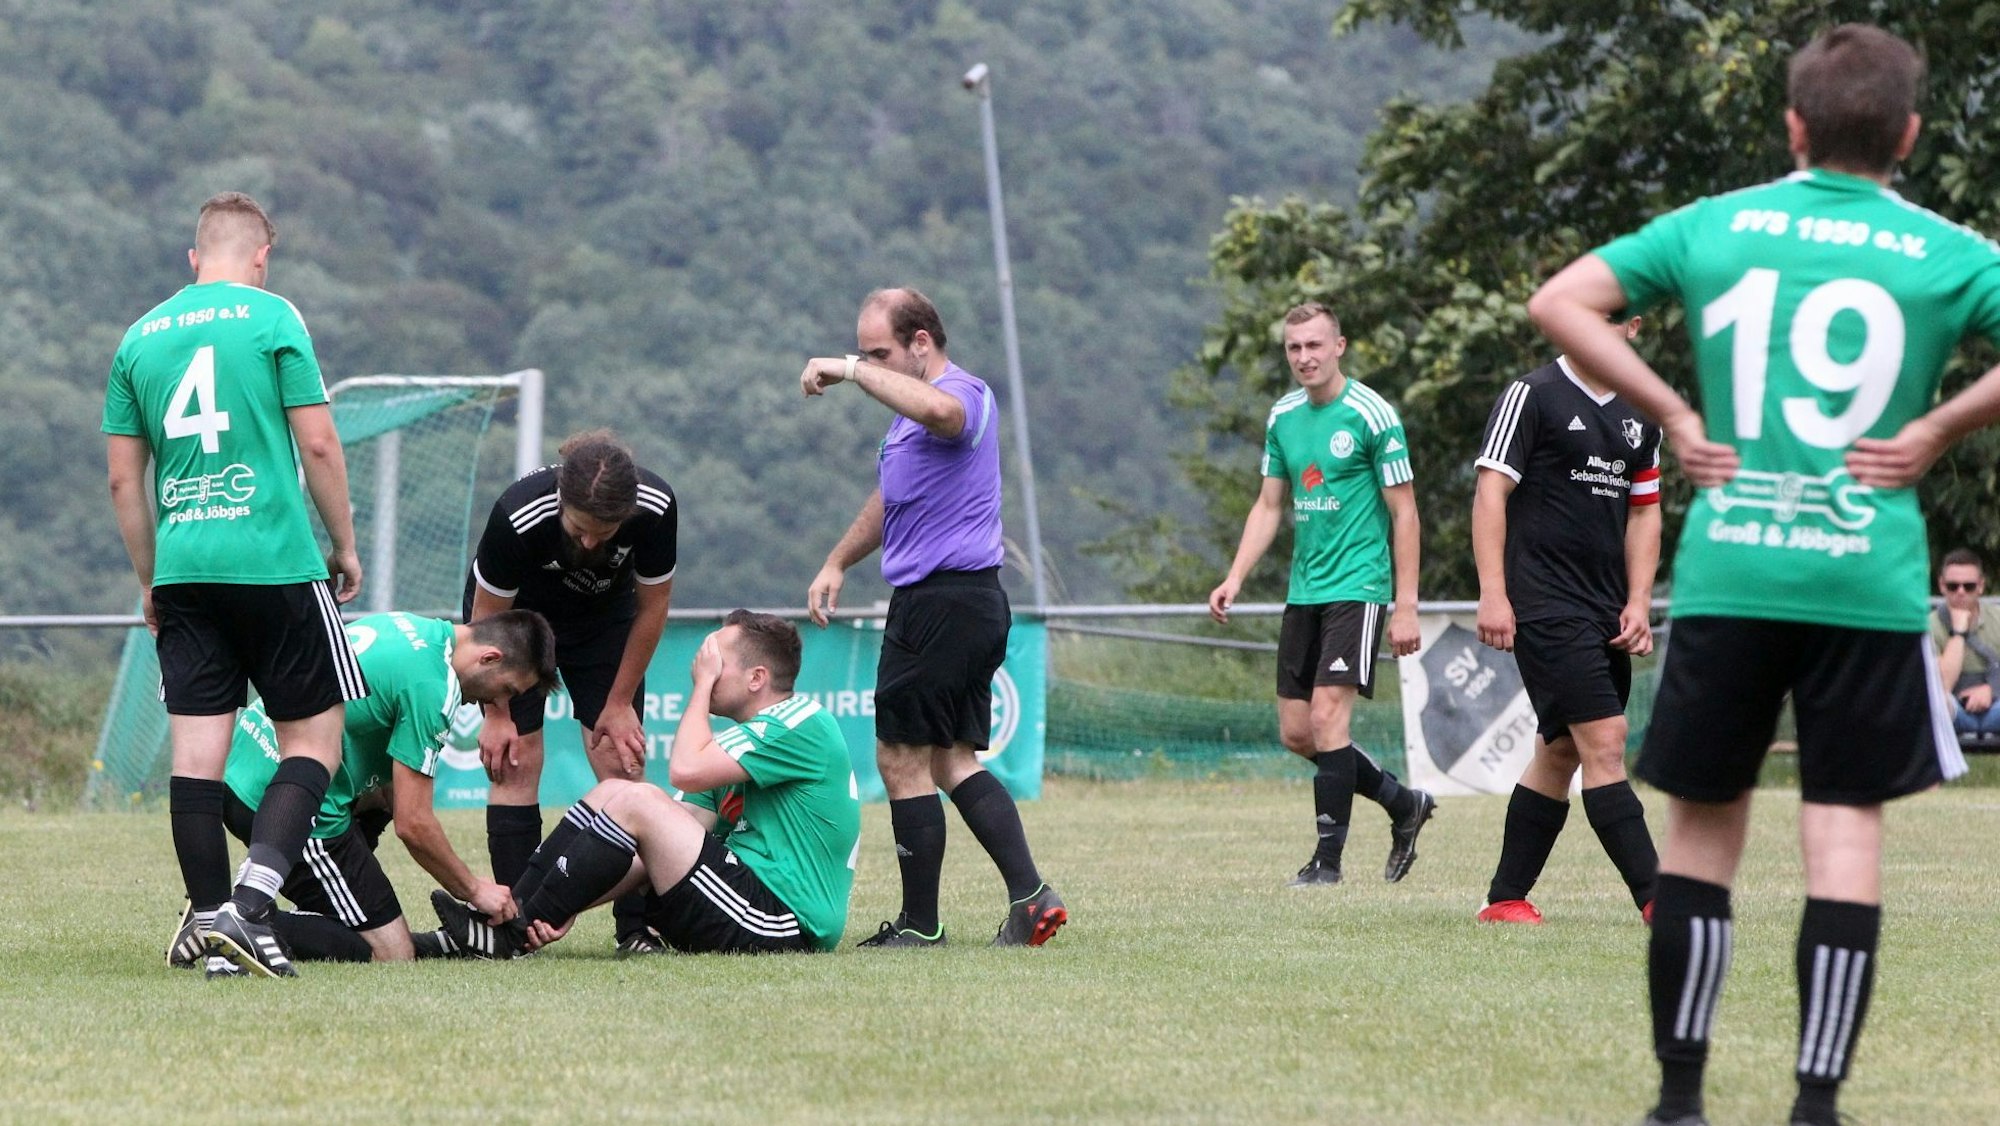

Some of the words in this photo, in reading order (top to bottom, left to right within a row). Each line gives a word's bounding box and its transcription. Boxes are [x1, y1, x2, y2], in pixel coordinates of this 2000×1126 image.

[1731, 210, 1790, 236] SVS
[1796, 217, 1870, 247] 1950
[1874, 231, 1928, 260] e.V.
[142, 316, 171, 336] SVS
[176, 307, 215, 328] 1950
[218, 304, 250, 319] e.V.
[1702, 268, 1906, 448] 19
[163, 345, 230, 454] 4
[194, 507, 204, 520] &
[205, 505, 250, 520] Jöbges
[1294, 496, 1340, 511] wissLife
[1707, 519, 1761, 545] Groß
[1763, 523, 1784, 547] &
[1786, 526, 1871, 557] Jöbges
[1444, 647, 1478, 686] SV
[252, 727, 261, 740] &
